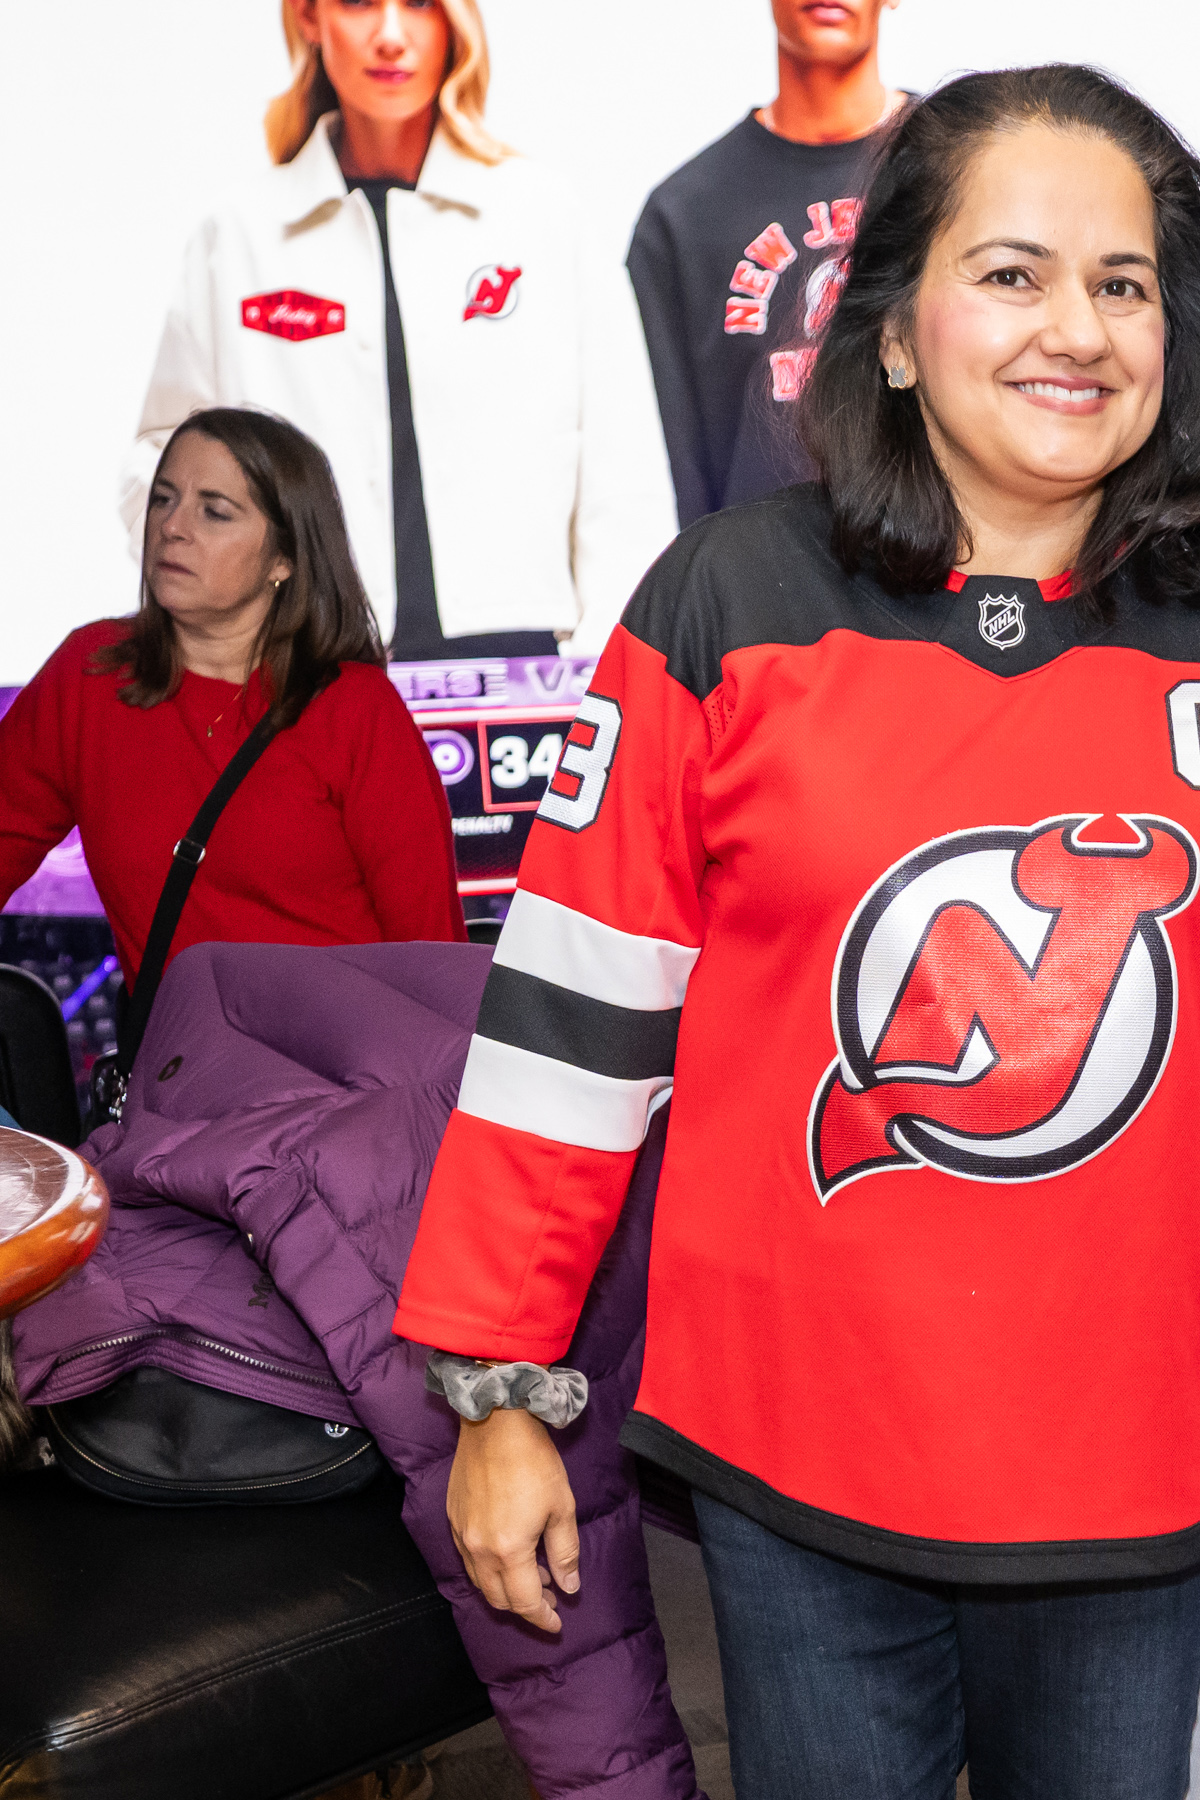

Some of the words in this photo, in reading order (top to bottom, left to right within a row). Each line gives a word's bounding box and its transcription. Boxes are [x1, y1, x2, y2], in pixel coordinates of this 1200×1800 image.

[724, 221, 798, 335] NEW
[988, 609, 1016, 637] NHL
[535, 690, 623, 834] 3
